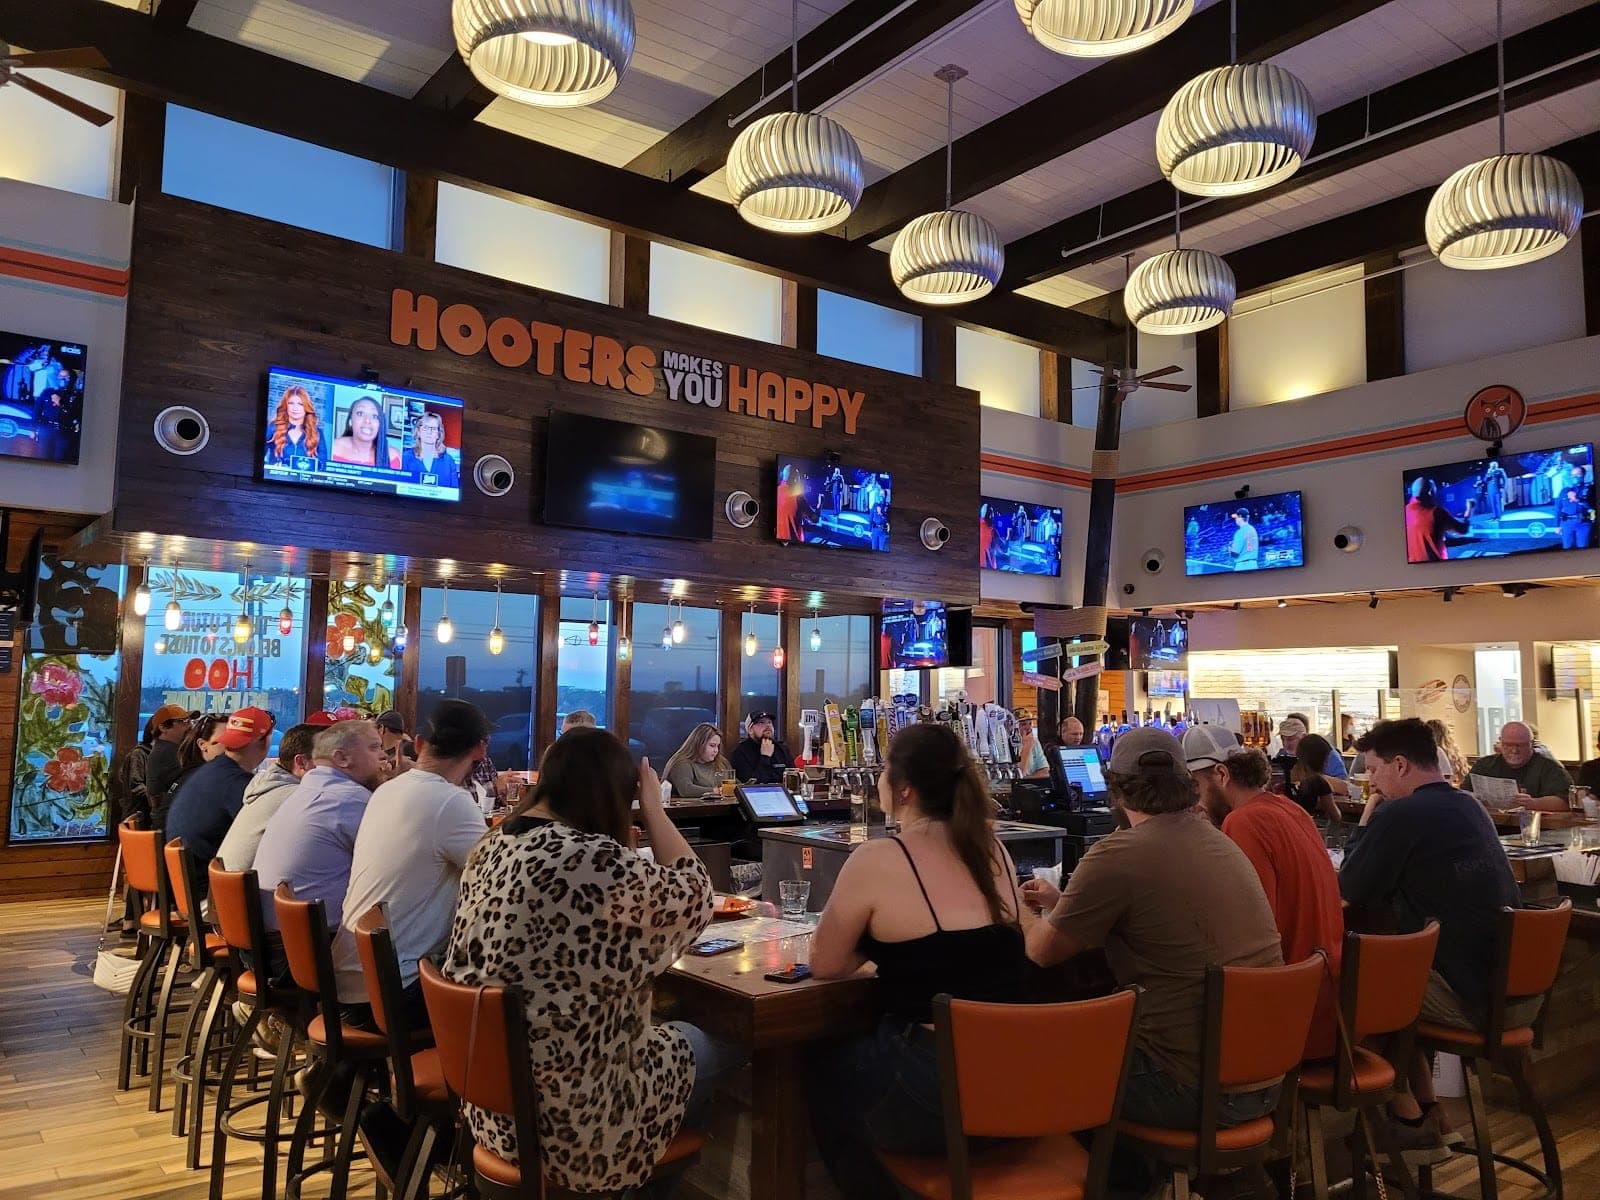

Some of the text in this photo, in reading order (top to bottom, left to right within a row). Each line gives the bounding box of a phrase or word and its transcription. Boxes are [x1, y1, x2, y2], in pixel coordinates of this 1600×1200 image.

[390, 288, 656, 396] HOOTERS
[663, 351, 723, 378] MAKES
[663, 368, 723, 408] YOU
[727, 364, 866, 435] HAPPY
